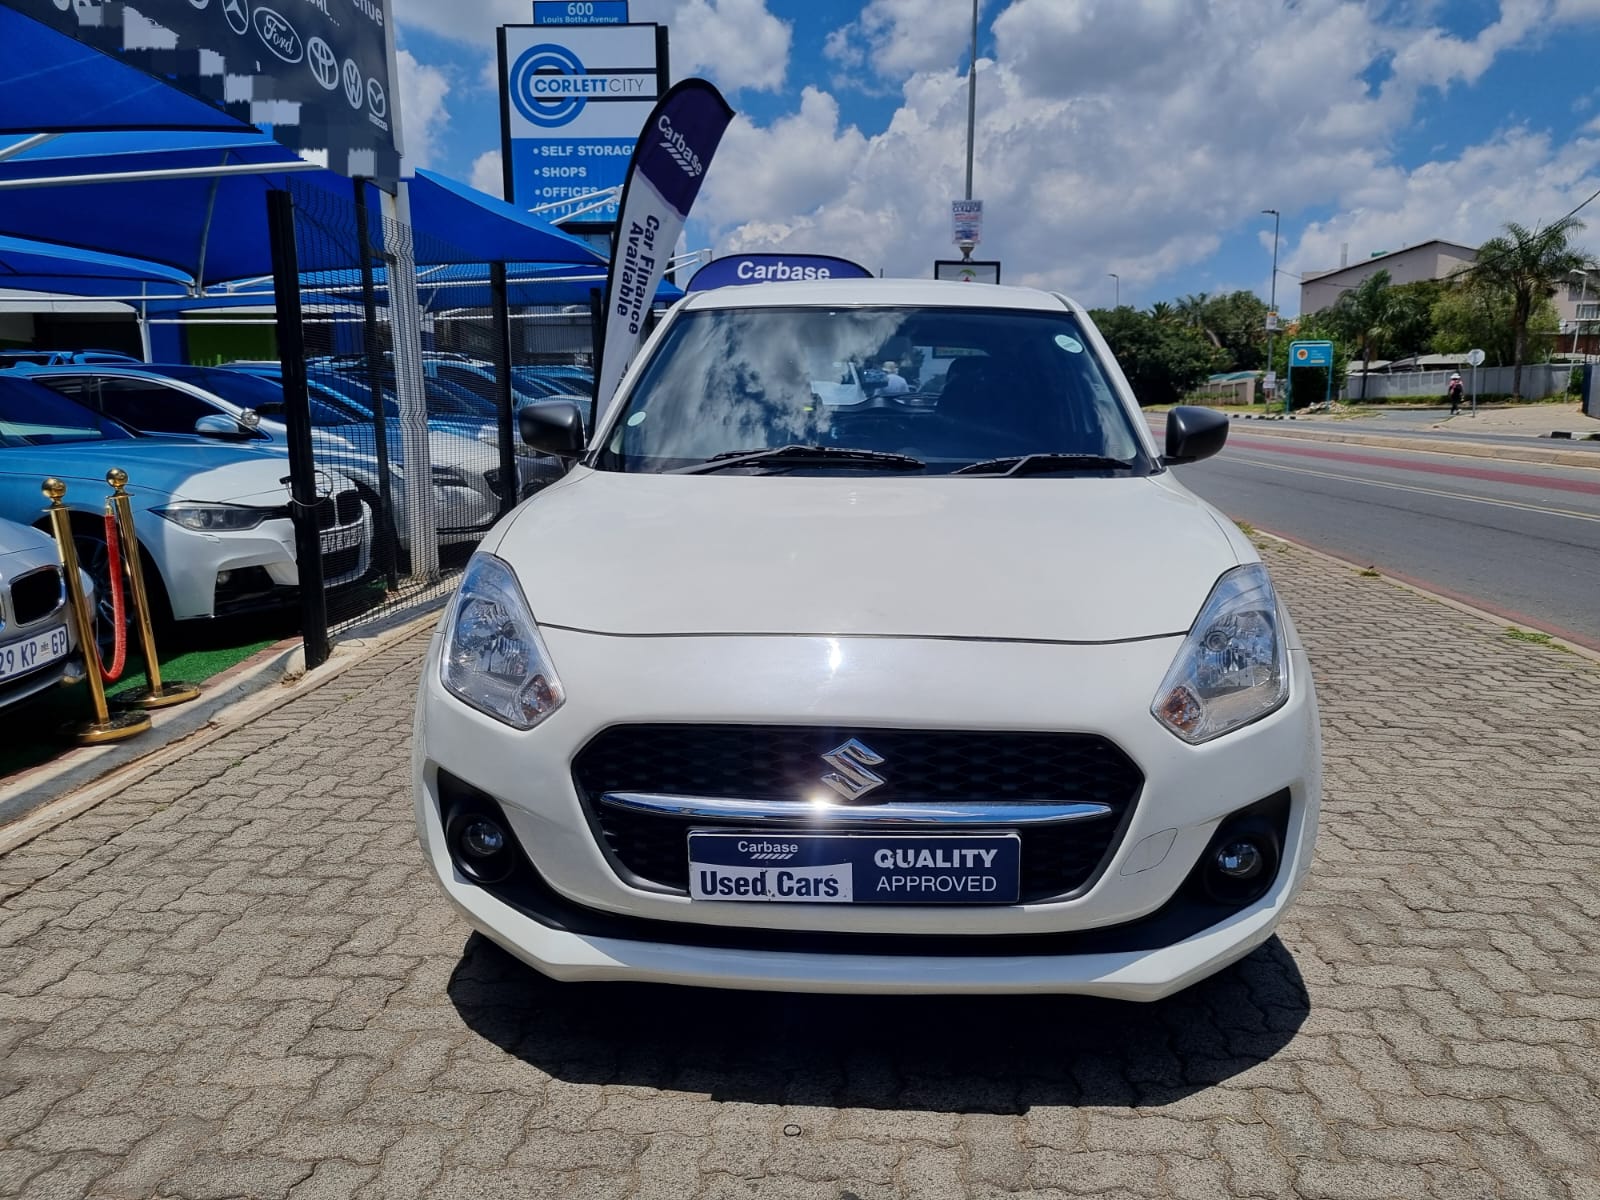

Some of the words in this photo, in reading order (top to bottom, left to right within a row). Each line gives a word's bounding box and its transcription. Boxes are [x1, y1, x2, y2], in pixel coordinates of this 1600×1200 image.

[543, 16, 563, 24] Louis
[565, 15, 588, 24] Botha
[589, 16, 619, 24] Avenue
[567, 2, 594, 16] 600
[264, 15, 294, 54] Ford
[541, 145, 574, 156] SELF
[658, 115, 702, 176] Carbase
[542, 166, 587, 177] SHOPS
[641, 214, 660, 251] Car
[617, 222, 643, 317] Available
[737, 260, 831, 281] Carbase
[629, 255, 655, 335] Finance
[21, 641, 37, 668] KP
[52, 630, 65, 655] GP
[737, 840, 799, 853] Carbase
[874, 848, 998, 868] QUALITY
[700, 870, 767, 897] Used
[776, 872, 839, 897] Cars
[876, 875, 997, 892] APPROVED
